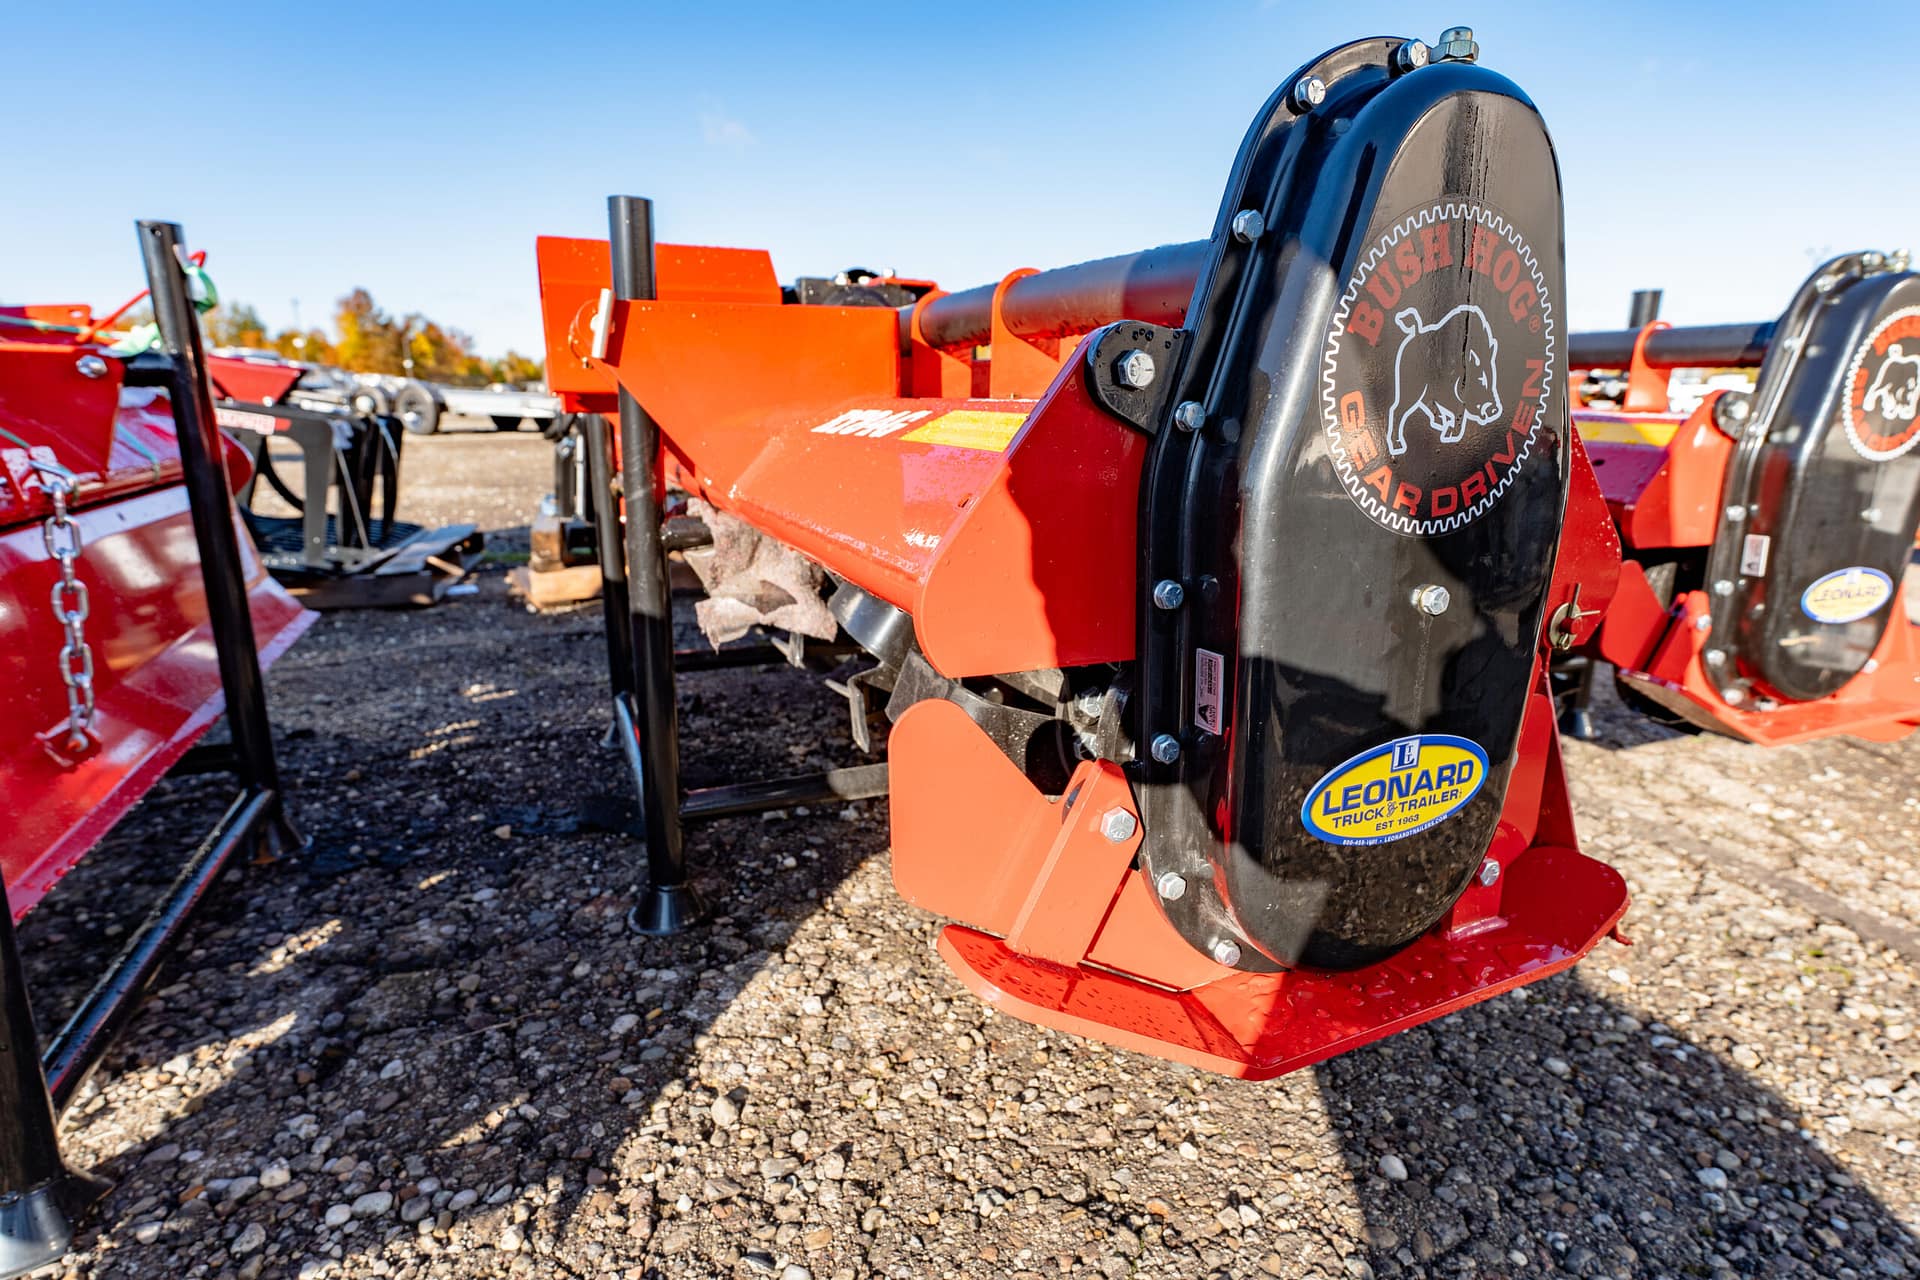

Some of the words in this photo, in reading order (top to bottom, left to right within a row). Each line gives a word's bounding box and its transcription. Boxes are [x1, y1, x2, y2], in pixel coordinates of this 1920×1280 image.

[1348, 223, 1453, 347] BUSH
[1465, 225, 1536, 323] HOG
[1340, 390, 1422, 516] GEAR
[1431, 359, 1544, 516] DRIVEN
[1323, 759, 1474, 816] LEONARD
[1332, 806, 1385, 829] TRUCK
[1399, 788, 1459, 813] TRAILER
[1376, 820, 1394, 831] EST
[1398, 813, 1420, 826] 1963
